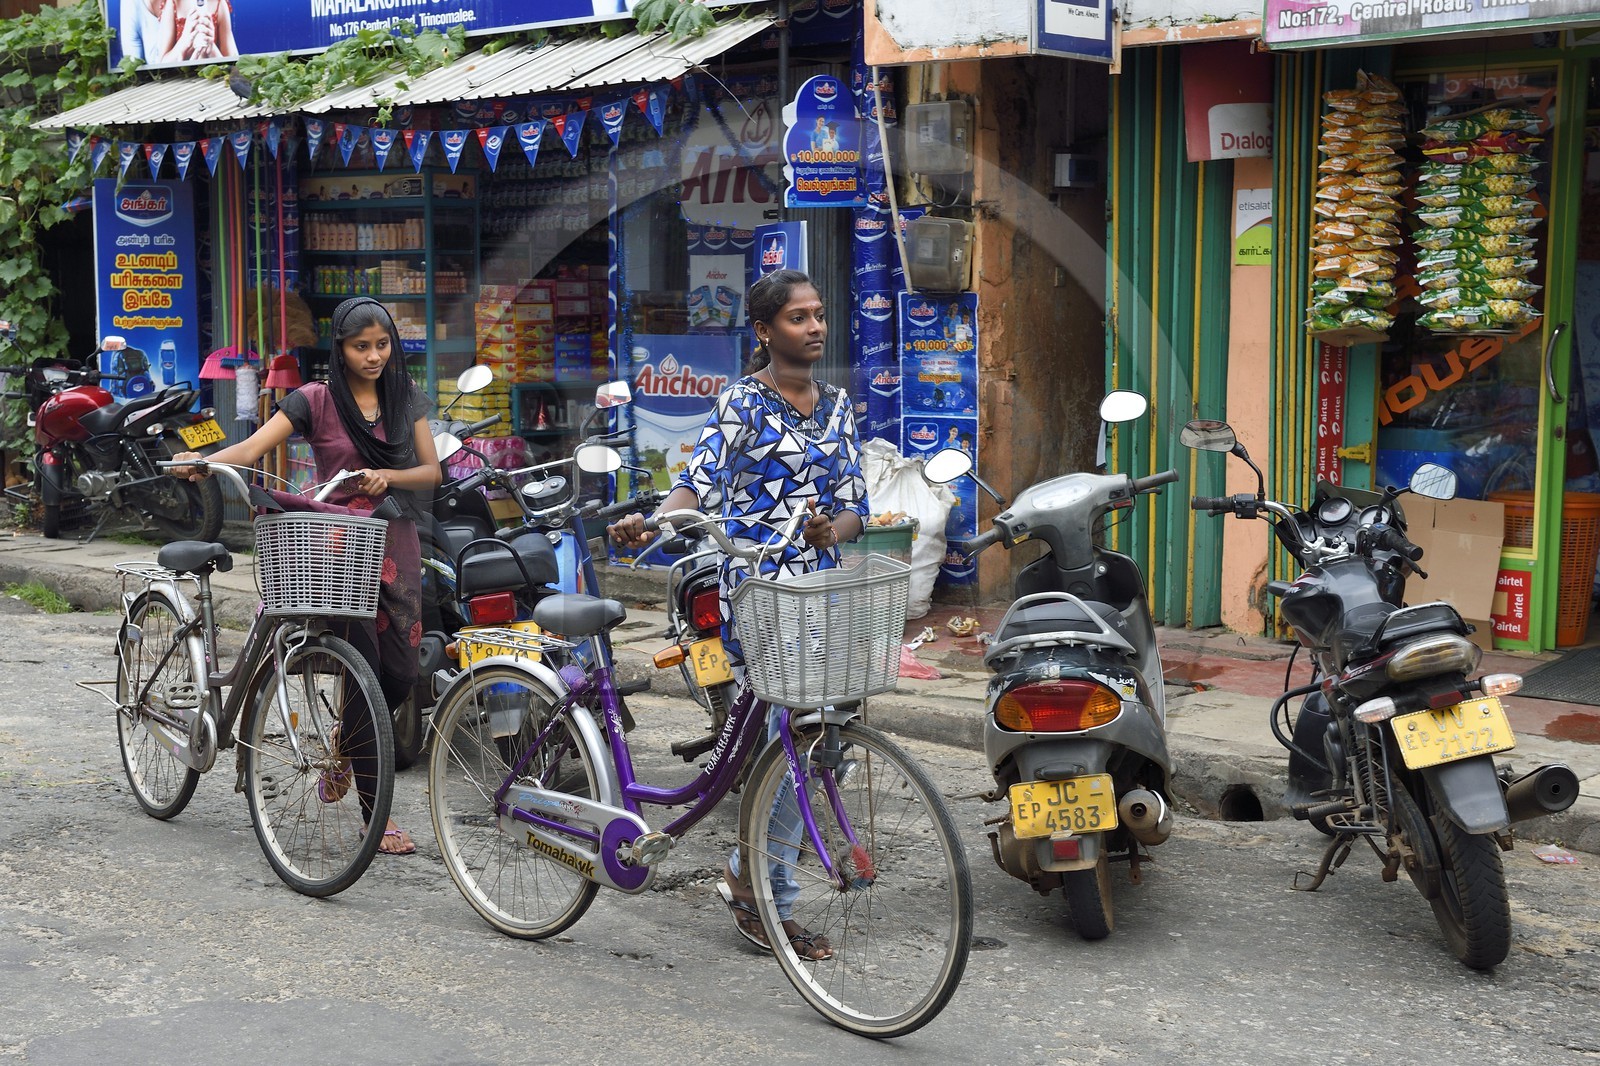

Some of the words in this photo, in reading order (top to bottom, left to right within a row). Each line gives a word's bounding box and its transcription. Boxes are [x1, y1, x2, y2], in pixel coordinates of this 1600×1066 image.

[419, 9, 477, 27] Trincomalee.
[1279, 5, 1344, 29] No:172,
[681, 144, 778, 205] Anc
[121, 197, 166, 211] அங்கர்
[1238, 200, 1271, 211] etisalat
[115, 251, 177, 270] உடனடிப்
[111, 270, 182, 289] பரிசுகளை
[123, 289, 171, 311] இங்கே
[635, 364, 728, 398] Anchor
[1320, 398, 1328, 423] airtel
[1498, 575, 1524, 588] airtel
[1513, 593, 1524, 619] airtel
[1496, 621, 1522, 634] airtel
[697, 653, 718, 672] EP
[704, 713, 737, 776] TOMAHAWK
[1404, 731, 1430, 750] EP
[1434, 727, 1499, 759] 2122
[1047, 781, 1079, 807] JC
[1017, 801, 1042, 820] EP
[1045, 805, 1101, 831] 4583
[526, 831, 595, 877] Tomahawk
